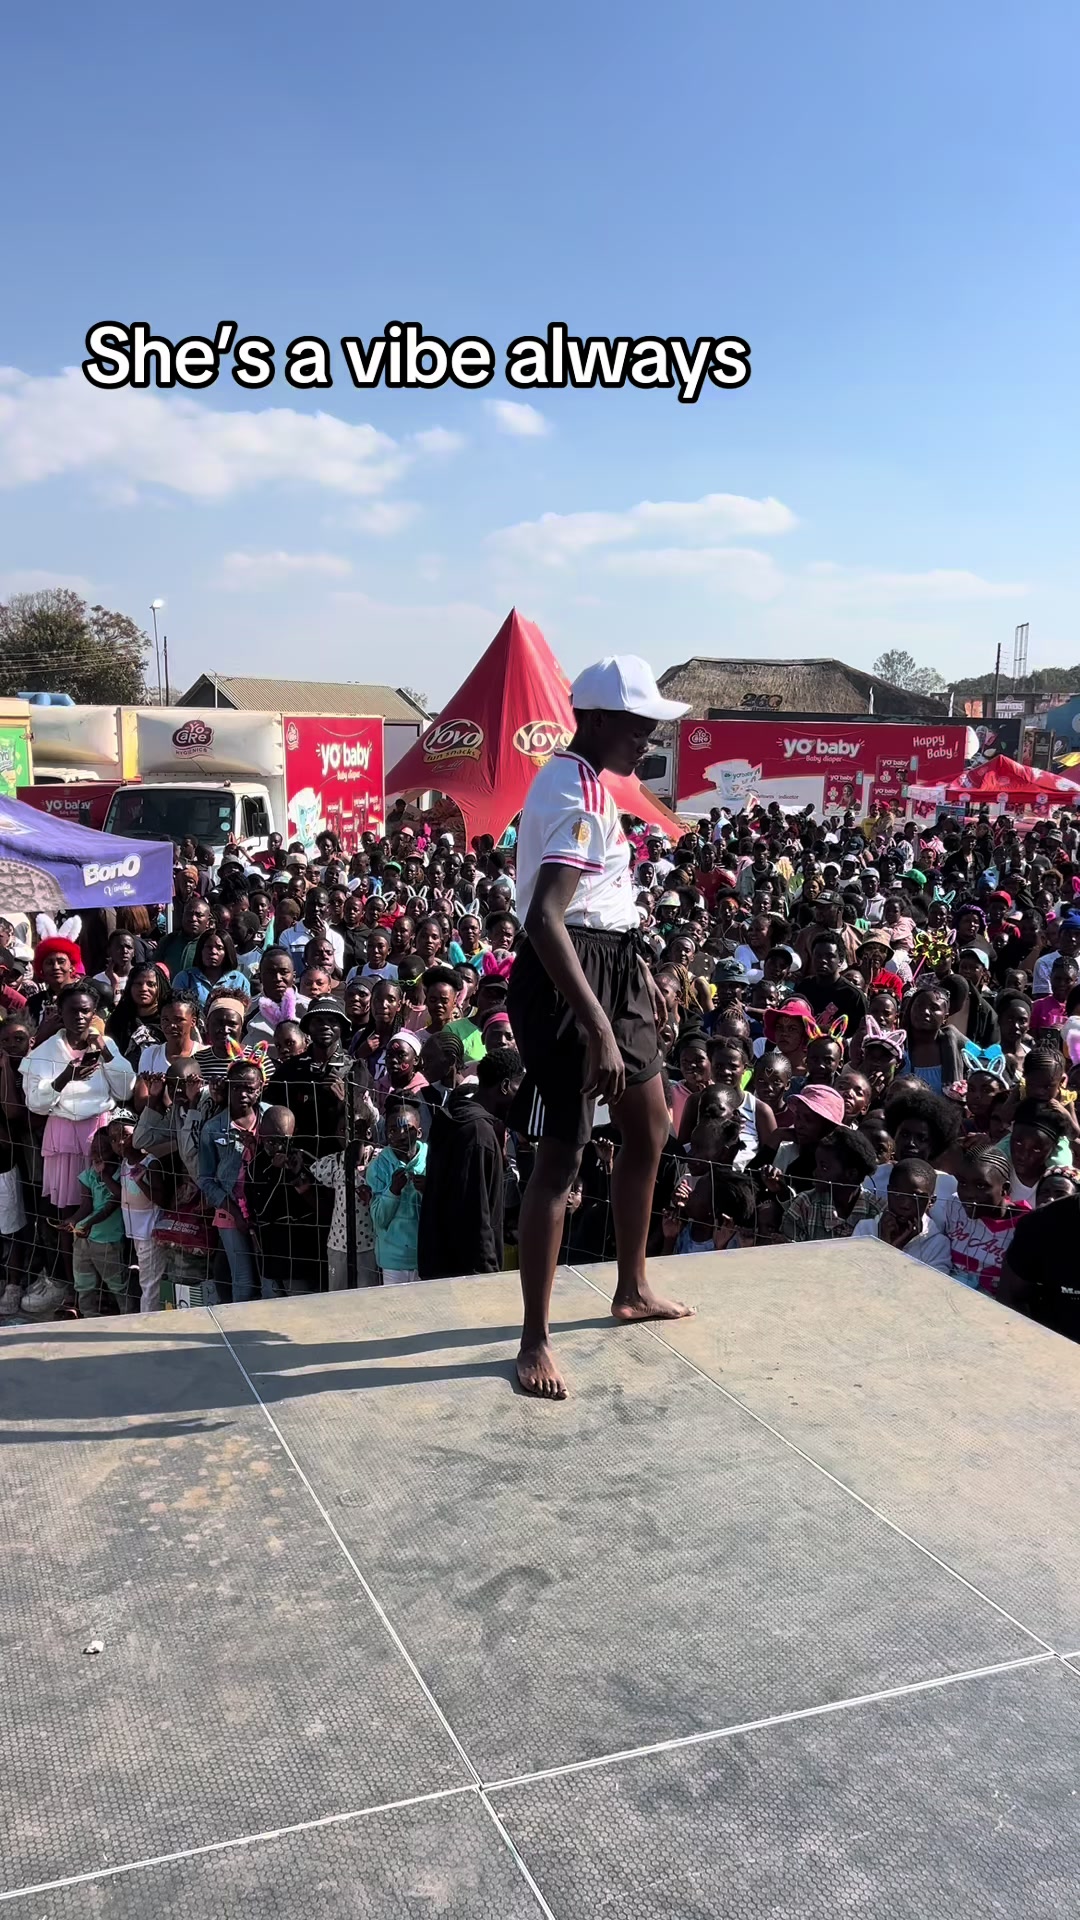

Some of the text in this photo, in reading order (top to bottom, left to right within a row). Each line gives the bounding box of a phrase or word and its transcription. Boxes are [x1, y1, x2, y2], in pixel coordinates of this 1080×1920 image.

[189, 721, 205, 734] Yo
[518, 722, 574, 751] Yoyo
[428, 722, 480, 752] Yoyo
[912, 734, 945, 748] Happy
[446, 748, 476, 758] snacks
[783, 738, 860, 758] yo baby
[927, 741, 959, 759] Baby!
[321, 741, 370, 776] yo baby
[893, 759, 909, 767] baby
[45, 799, 63, 812] yo
[948, 1221, 970, 1241] Los
